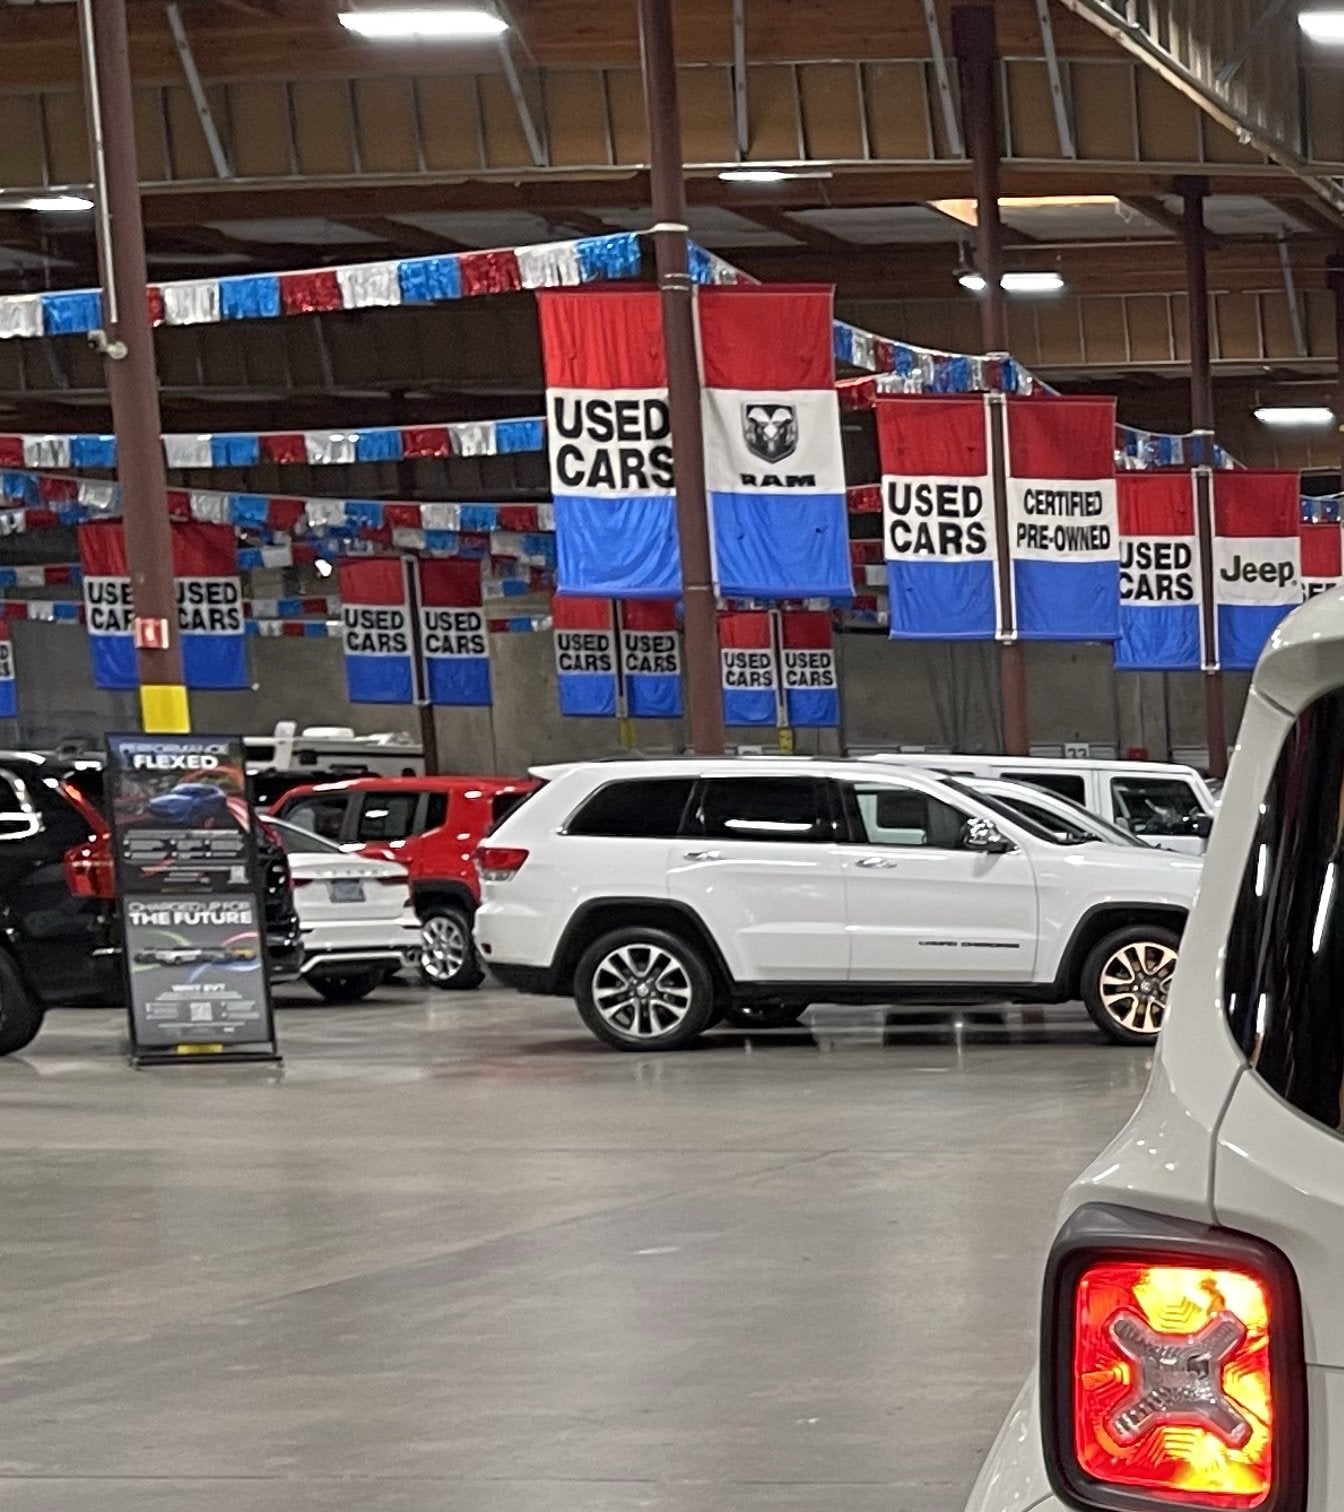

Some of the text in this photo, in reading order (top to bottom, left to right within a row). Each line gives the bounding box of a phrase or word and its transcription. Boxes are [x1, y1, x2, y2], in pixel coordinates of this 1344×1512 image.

[554, 397, 671, 442] USED
[556, 444, 675, 489] CARS
[740, 473, 816, 487] RAM
[888, 482, 982, 518] USED
[1023, 488, 1102, 517] CERTIFIED
[889, 519, 987, 555] CARS
[1017, 522, 1111, 551] PRE-OWNED
[1119, 541, 1191, 570] USED
[1220, 555, 1294, 587] Jeep
[88, 582, 132, 604] USE
[1120, 571, 1193, 601] CARS
[91, 607, 133, 630] CA
[344, 608, 404, 630] USED
[425, 611, 481, 631] USED
[346, 632, 407, 652] CARS
[426, 633, 485, 654] CARS
[558, 634, 609, 651] USED
[625, 634, 675, 651] USED
[559, 653, 611, 671] CARS
[625, 654, 677, 672] CARS
[724, 652, 771, 668] USED
[785, 652, 831, 668] USED
[725, 670, 773, 686] CARS
[786, 670, 833, 686] CARS
[133, 755, 218, 769] FLEXED
[129, 911, 252, 925] THE FUTURE
